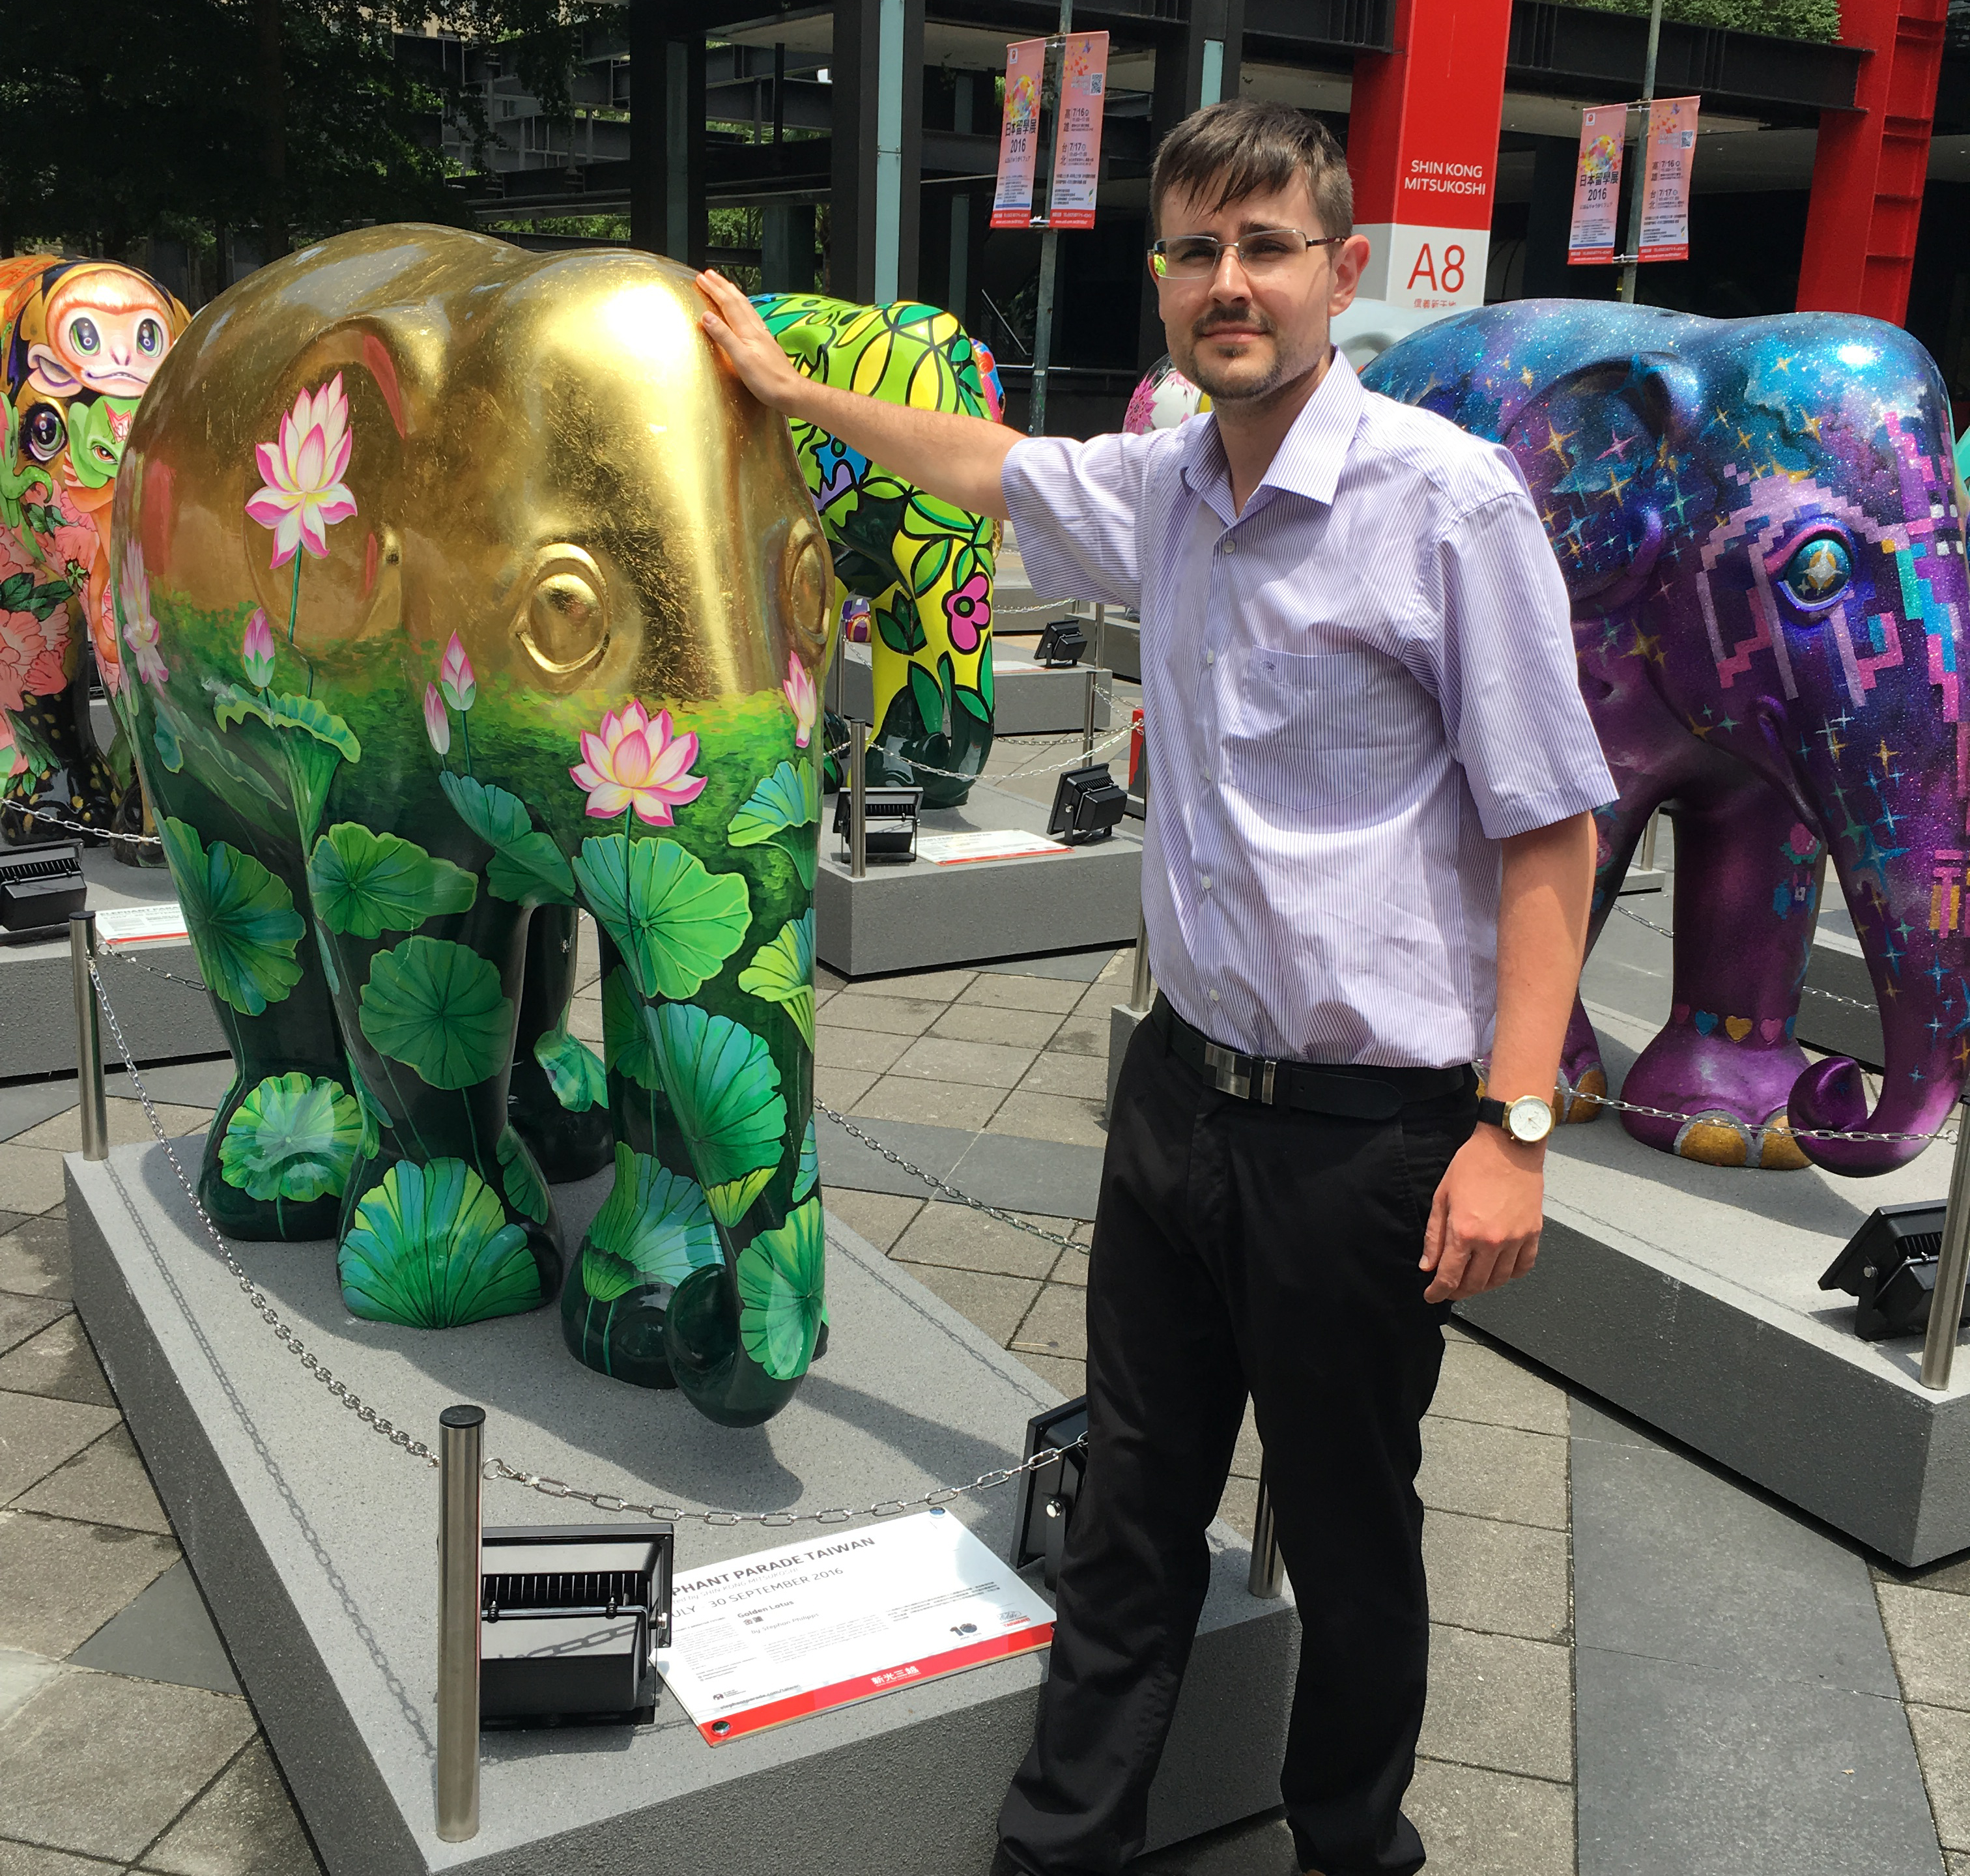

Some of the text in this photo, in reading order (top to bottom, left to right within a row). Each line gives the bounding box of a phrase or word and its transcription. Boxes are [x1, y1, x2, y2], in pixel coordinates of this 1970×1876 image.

[1005, 119, 1036, 137] 日本留學展
[1010, 138, 1026, 153] 2016
[1411, 160, 1483, 178] SHIN KONG
[1405, 177, 1486, 195] MITSUKOSHI
[1580, 171, 1619, 187] 日本留學展
[1588, 188, 1607, 201] 2016
[1406, 243, 1464, 293] A8
[672, 1537, 875, 1596] PHANT PARADE TAIWAN
[700, 1588, 721, 1597] SHIN
[723, 1581, 747, 1591] KONG
[749, 1567, 798, 1584] MITSUKOSHI
[671, 1605, 696, 1617] ULY
[708, 1598, 727, 1608] 30
[728, 1576, 810, 1602] SEPTEMBER
[812, 1568, 844, 1580] 2016
[737, 1600, 794, 1618] Golden Lotus
[871, 1666, 920, 1684] 新光三越
